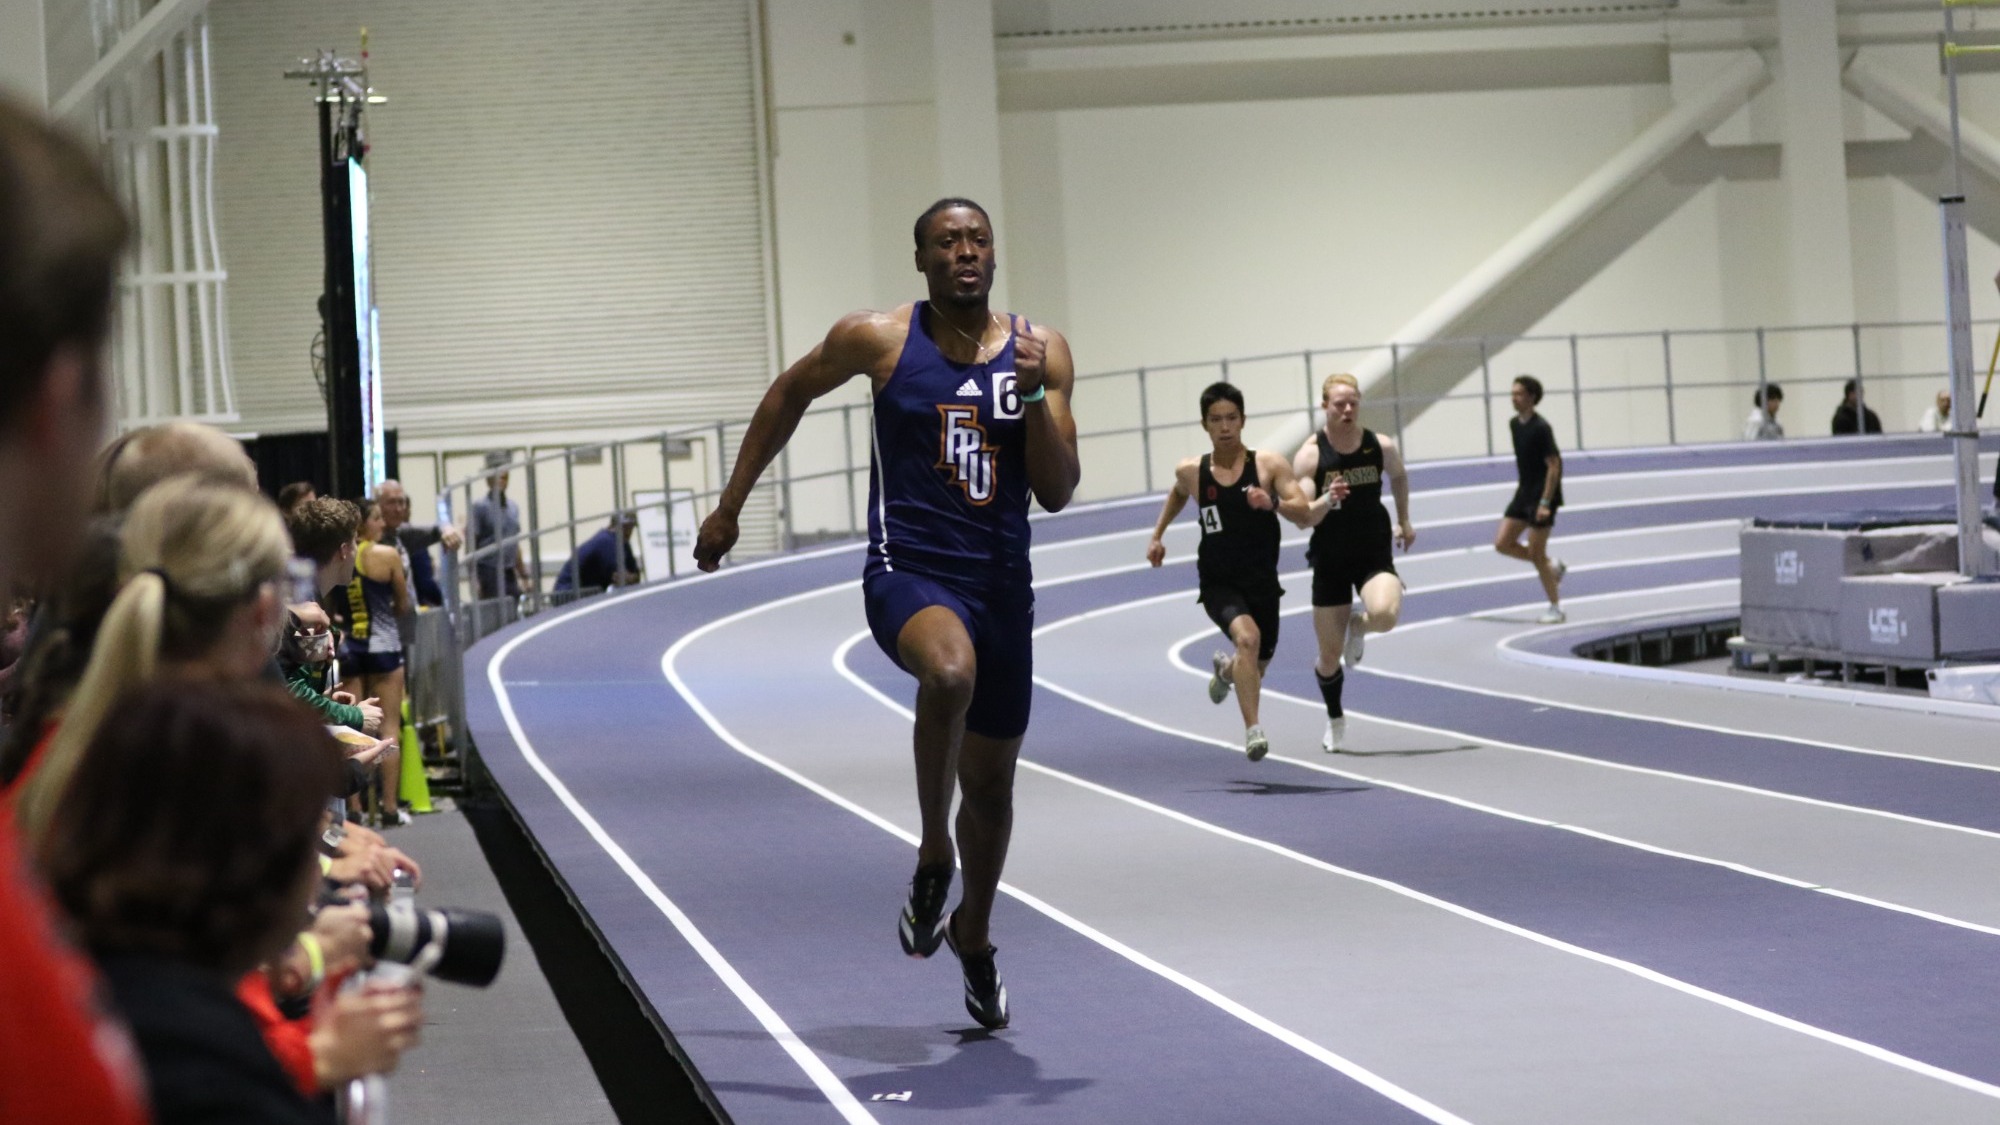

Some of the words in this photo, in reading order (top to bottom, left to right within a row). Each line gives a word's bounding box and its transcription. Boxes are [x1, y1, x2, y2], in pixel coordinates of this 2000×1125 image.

[1000, 375, 1023, 416] 6
[940, 407, 996, 503] FPU
[1206, 508, 1218, 530] 4
[1869, 607, 1898, 633] UCS
